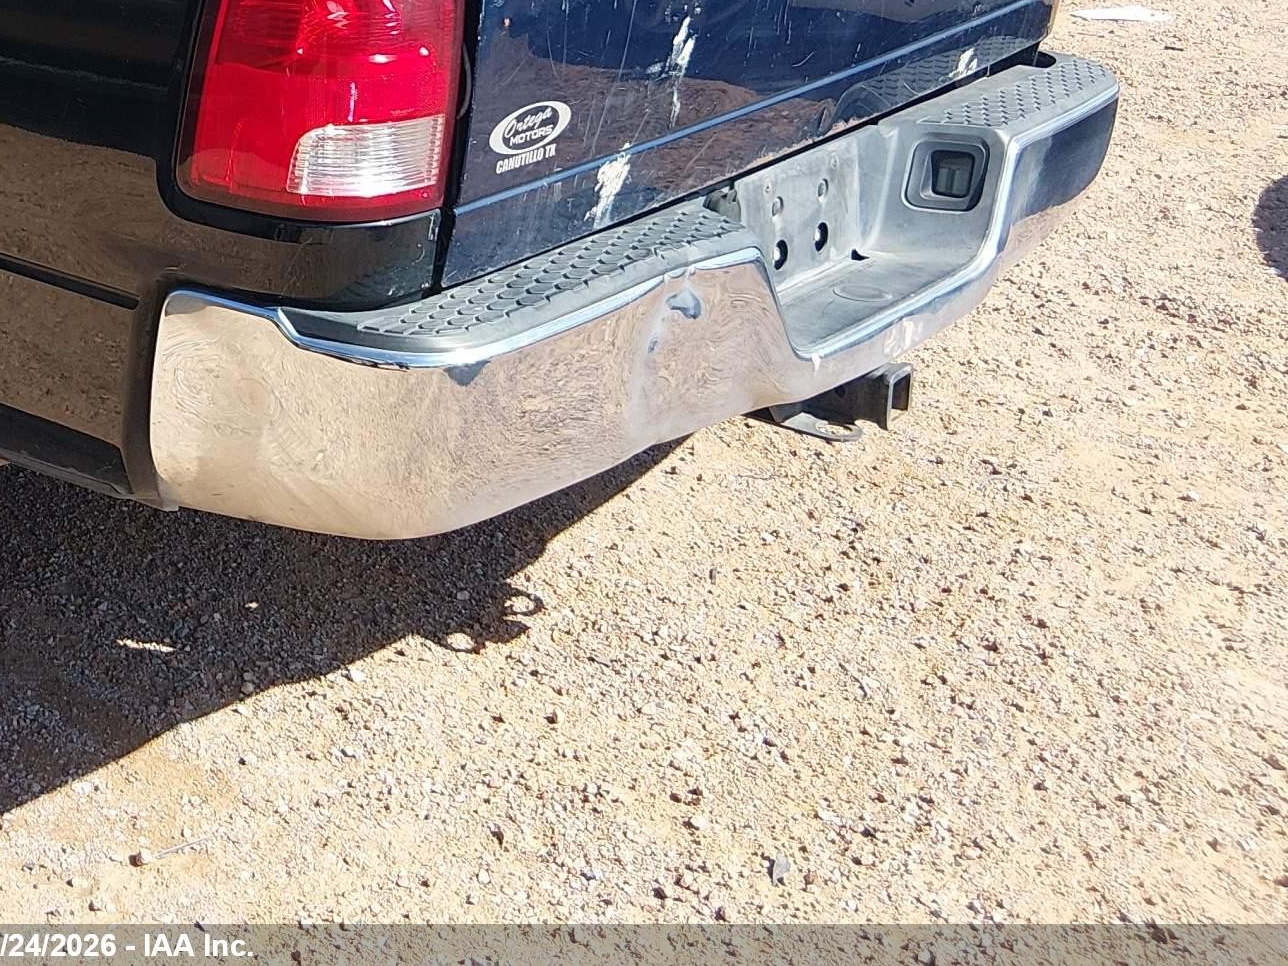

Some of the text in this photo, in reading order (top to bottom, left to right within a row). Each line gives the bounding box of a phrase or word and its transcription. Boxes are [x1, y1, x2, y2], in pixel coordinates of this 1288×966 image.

[504, 106, 553, 138] Ortega
[509, 124, 554, 146] MOTORS
[495, 143, 557, 174] CANUTILLO TX
